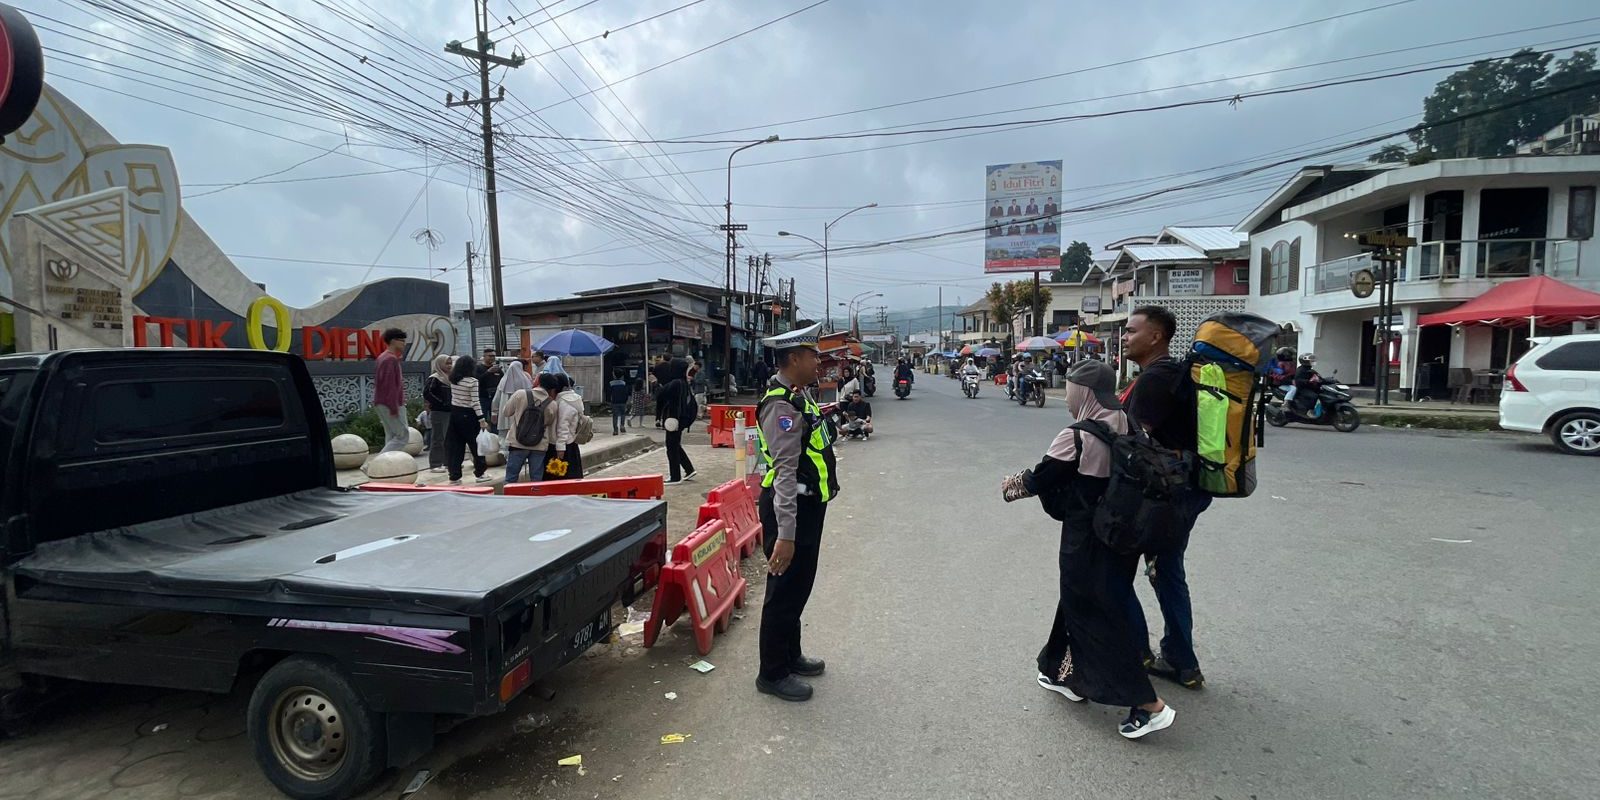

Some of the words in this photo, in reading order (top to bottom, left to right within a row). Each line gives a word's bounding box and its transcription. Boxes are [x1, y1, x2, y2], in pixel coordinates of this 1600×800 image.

[1003, 179, 1021, 189] Idul
[1023, 178, 1044, 188] Fitri
[302, 325, 389, 361] DIEN
[573, 621, 594, 649] 9787
